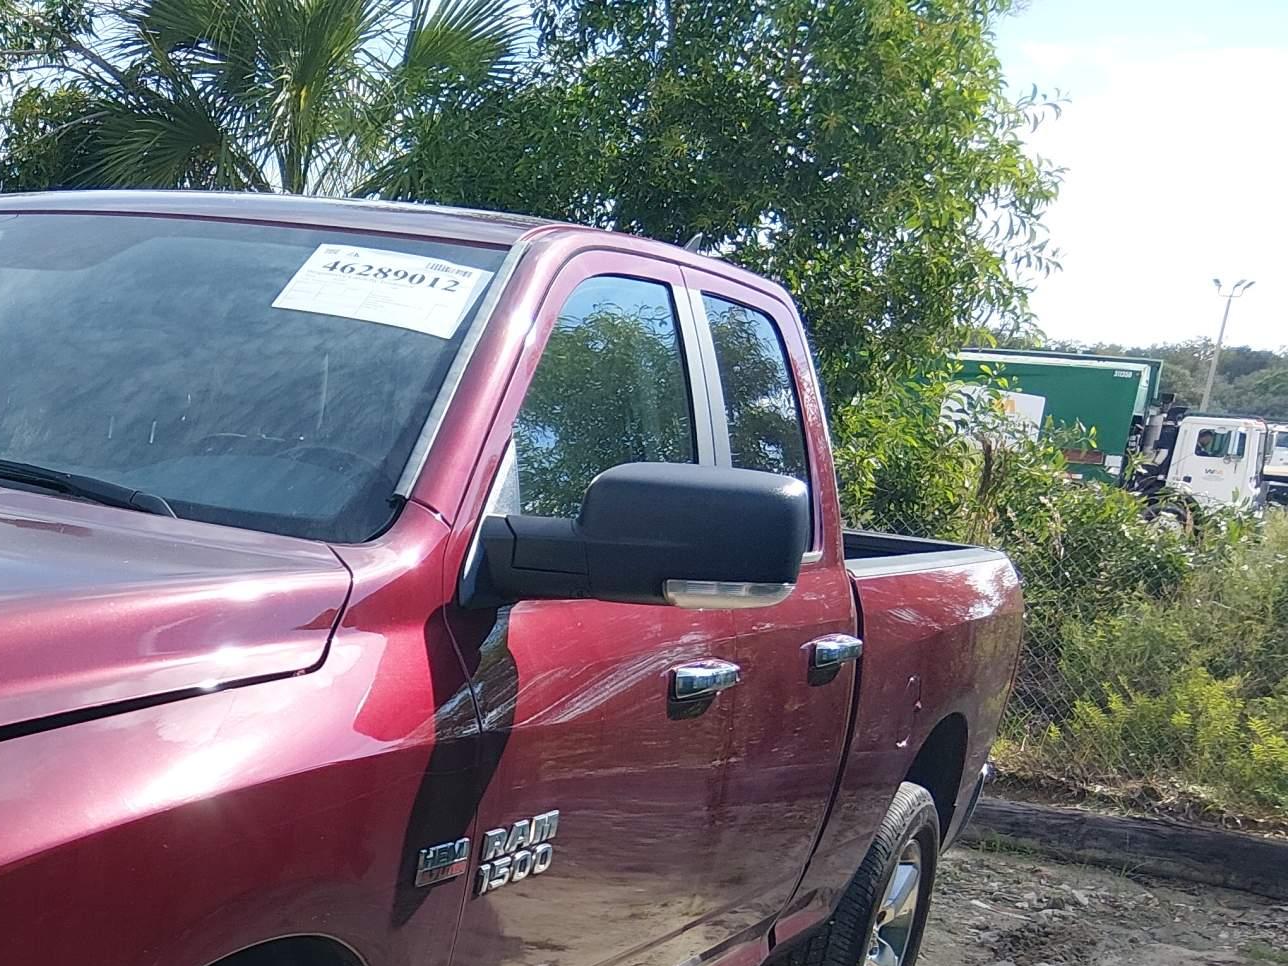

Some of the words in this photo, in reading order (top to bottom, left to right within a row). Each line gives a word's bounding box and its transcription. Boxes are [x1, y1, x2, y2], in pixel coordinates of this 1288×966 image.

[322, 260, 460, 292] 46289012
[482, 809, 560, 862] RAM
[476, 842, 553, 896] 1500
